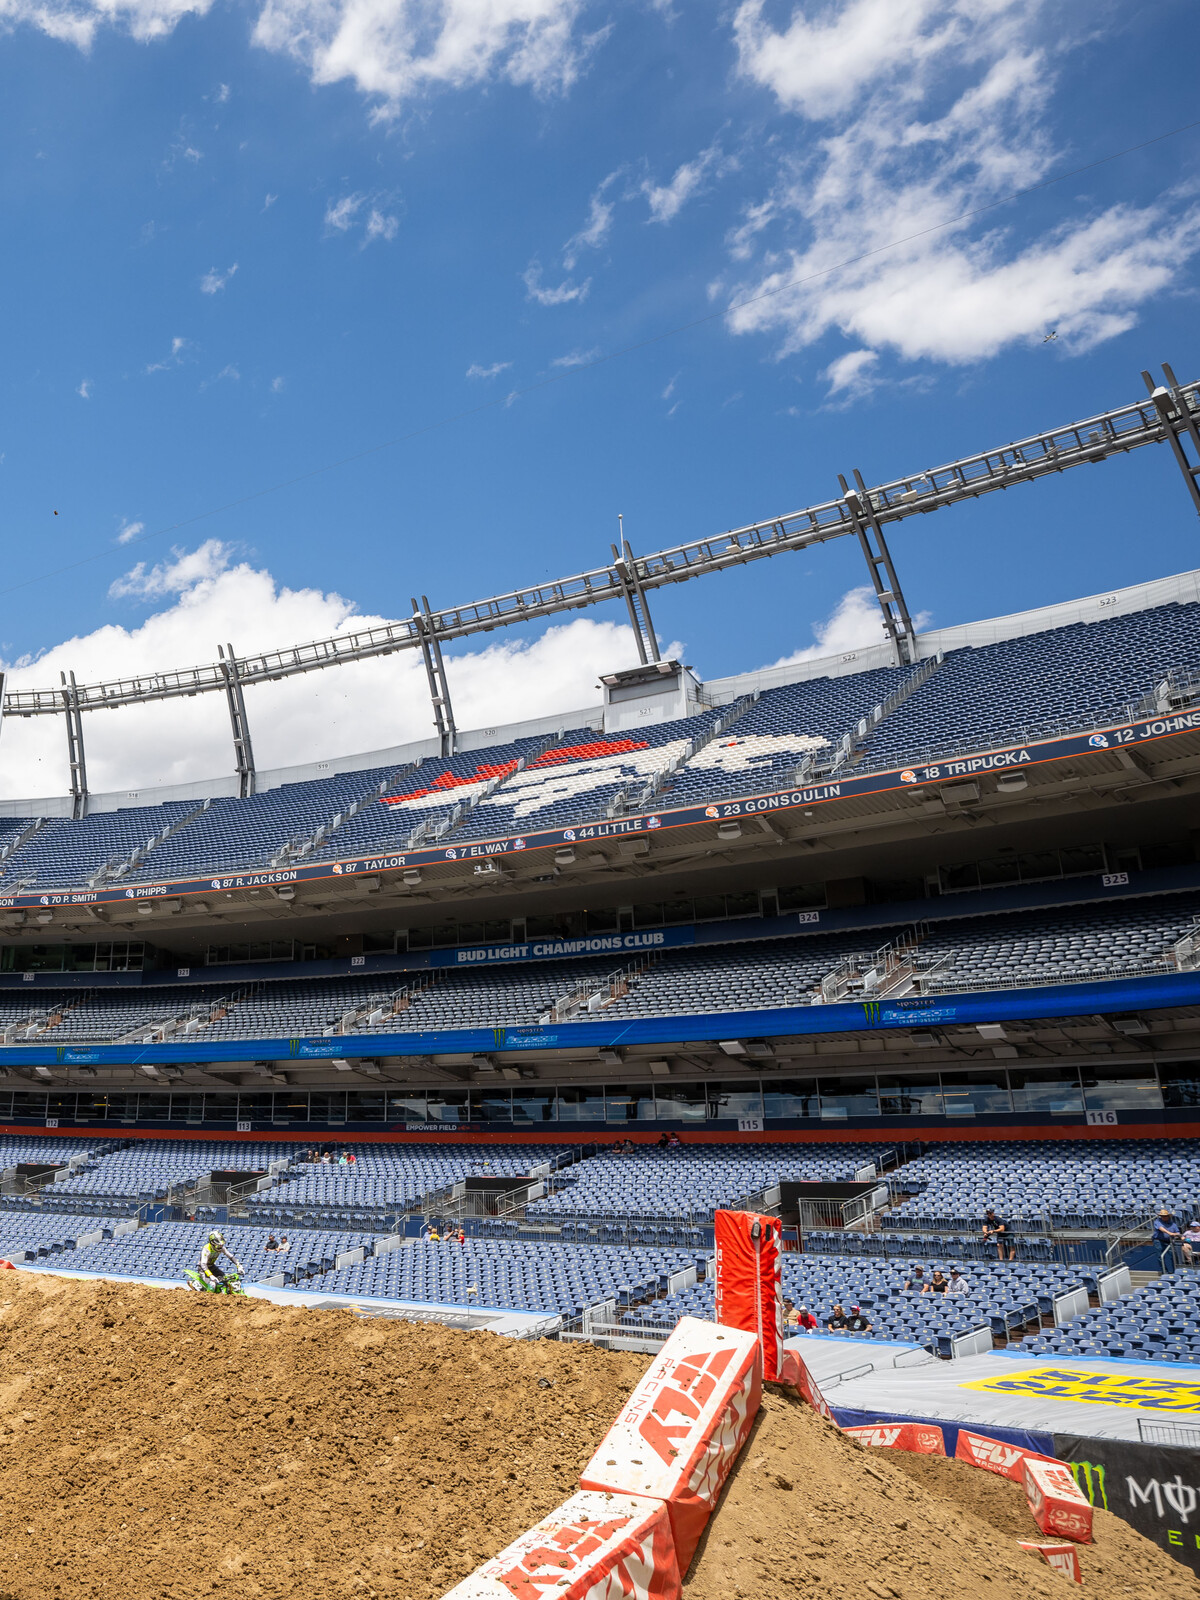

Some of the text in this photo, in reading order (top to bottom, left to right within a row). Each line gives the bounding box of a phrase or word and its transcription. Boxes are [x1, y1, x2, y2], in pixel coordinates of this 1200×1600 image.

[1100, 596, 1117, 606] 523
[842, 653, 856, 662] 522
[1113, 714, 1200, 744] 12 JOHNS
[922, 750, 1031, 780] 18 TRIPUCKA
[723, 784, 841, 817] 23 GONSOULIN
[579, 819, 642, 839] 44 LITTLE
[460, 842, 509, 858] 7 ELWAY
[345, 855, 406, 873] 87 TAYLOR
[222, 870, 298, 888] 87 R. JACKSON
[1104, 874, 1127, 886] 325
[51, 895, 61, 904] 70
[71, 892, 97, 903] SMITH
[136, 886, 167, 897] PHIPPS
[800, 914, 818, 922] 324
[458, 933, 664, 962] BUD LIGHT CHAMPIONS CLUB
[352, 957, 364, 965] 322
[238, 1122, 250, 1131] 113
[740, 1120, 759, 1130] 115
[1090, 1111, 1116, 1124] 116
[624, 1356, 673, 1425] RACING
[1029, 1370, 1200, 1396] SUZ
[984, 1380, 1200, 1412] SUZU
[638, 1347, 738, 1468] FLY
[921, 1432, 938, 1448] 25
[968, 1436, 1025, 1467] FLY
[974, 1458, 1010, 1474] RACING
[1126, 1474, 1200, 1524] MO
[1055, 1509, 1084, 1528] 25
